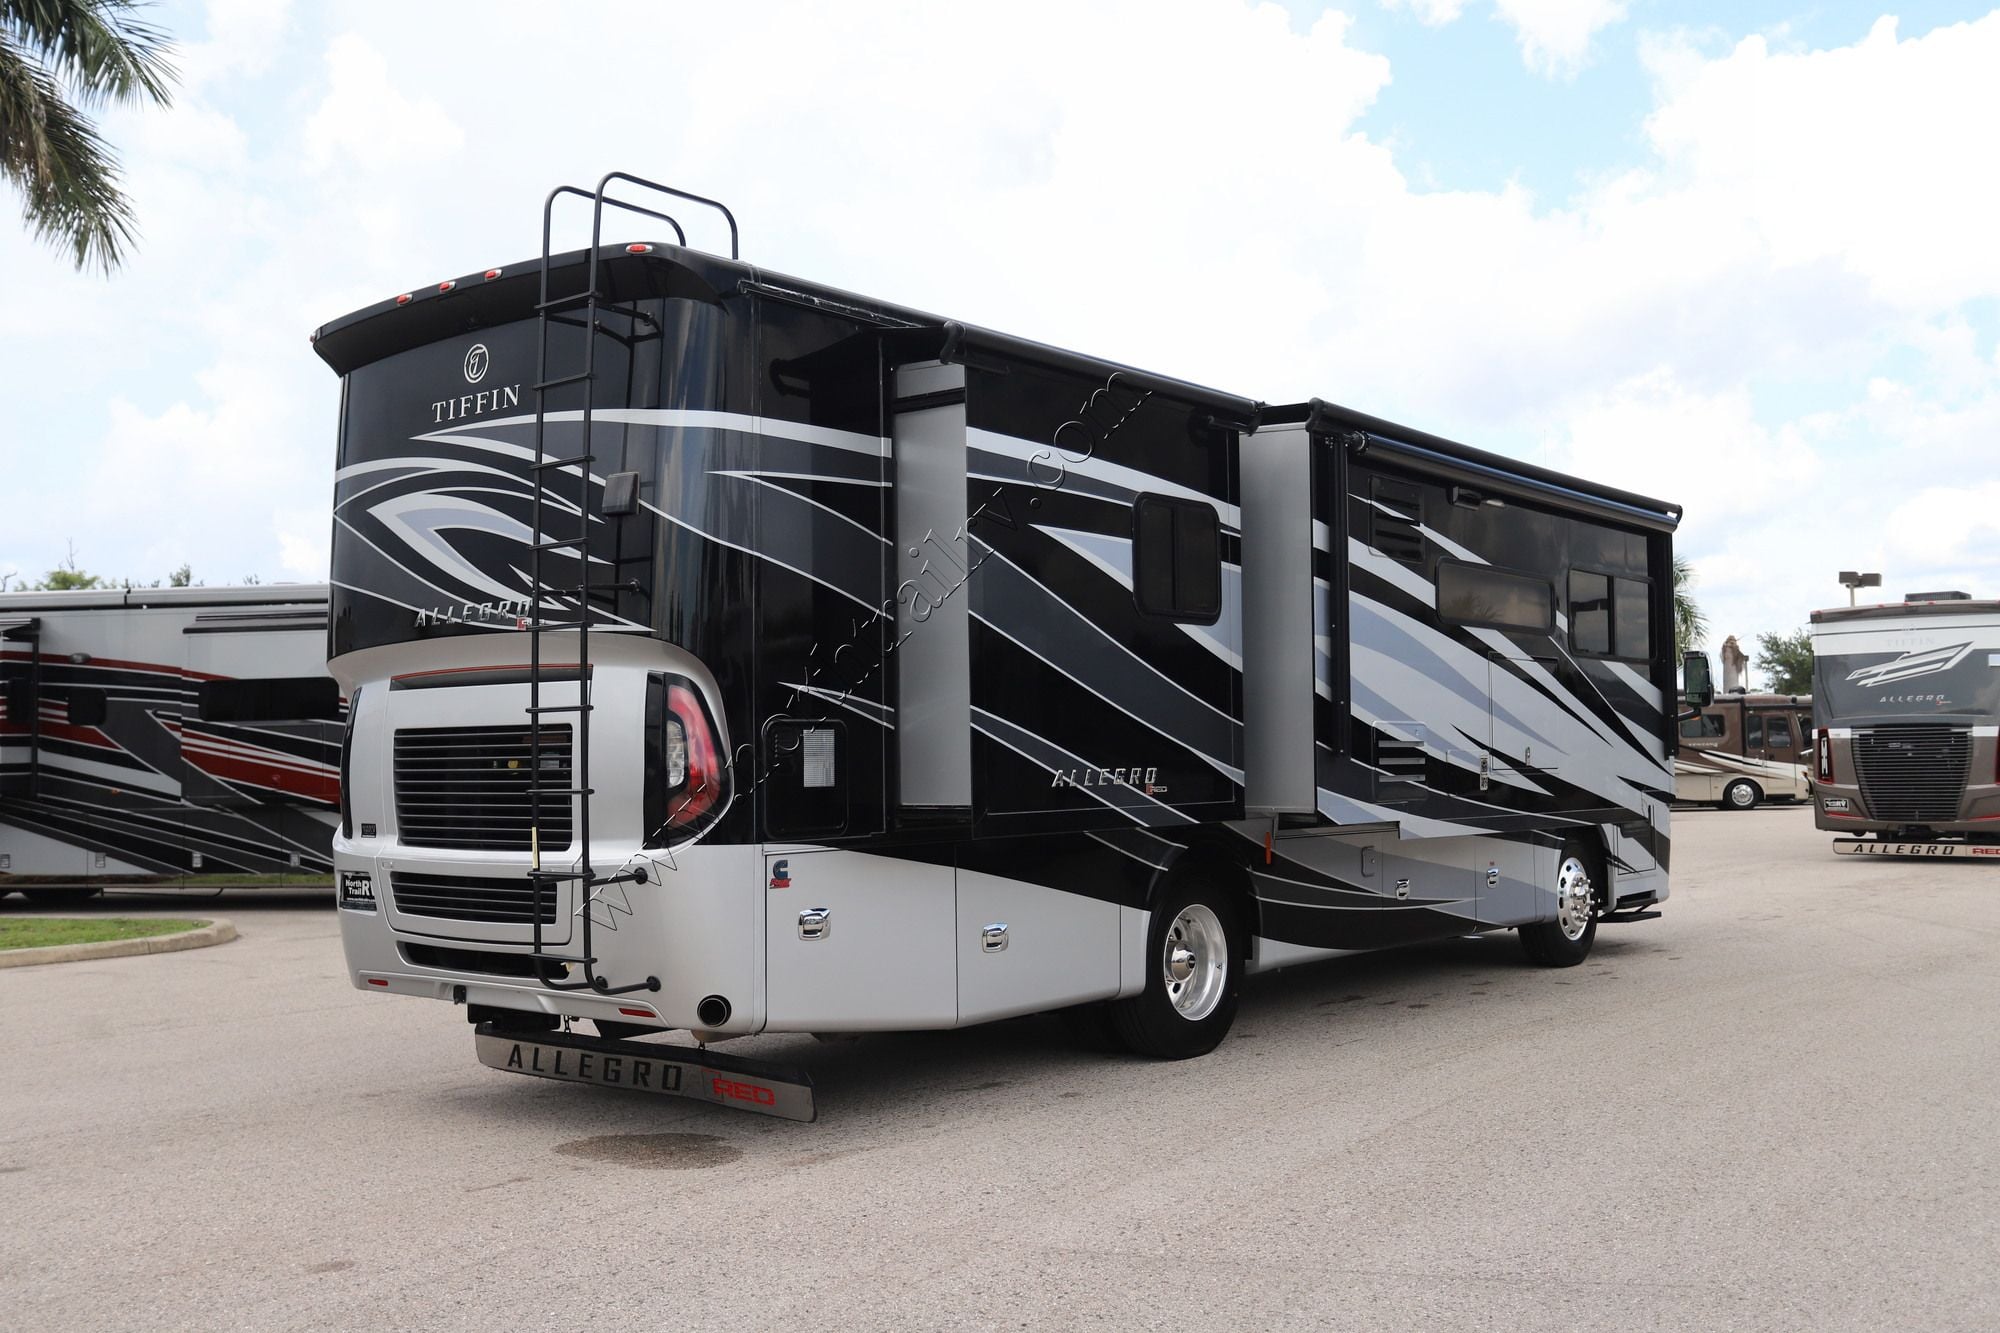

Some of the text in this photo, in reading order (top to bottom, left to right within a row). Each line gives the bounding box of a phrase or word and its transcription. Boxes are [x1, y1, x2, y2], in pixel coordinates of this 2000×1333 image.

[431, 384, 521, 423] TIFFIN
[414, 600, 533, 628] ALLEGRO
[1880, 694, 1945, 703] ALLEGRO
[1051, 767, 1158, 788] ALLEGRO
[1853, 844, 1956, 856] ALLEGRO
[345, 879, 362, 888] North
[348, 887, 362, 895] Trail
[507, 1044, 777, 1107] ALLEGRO RED
